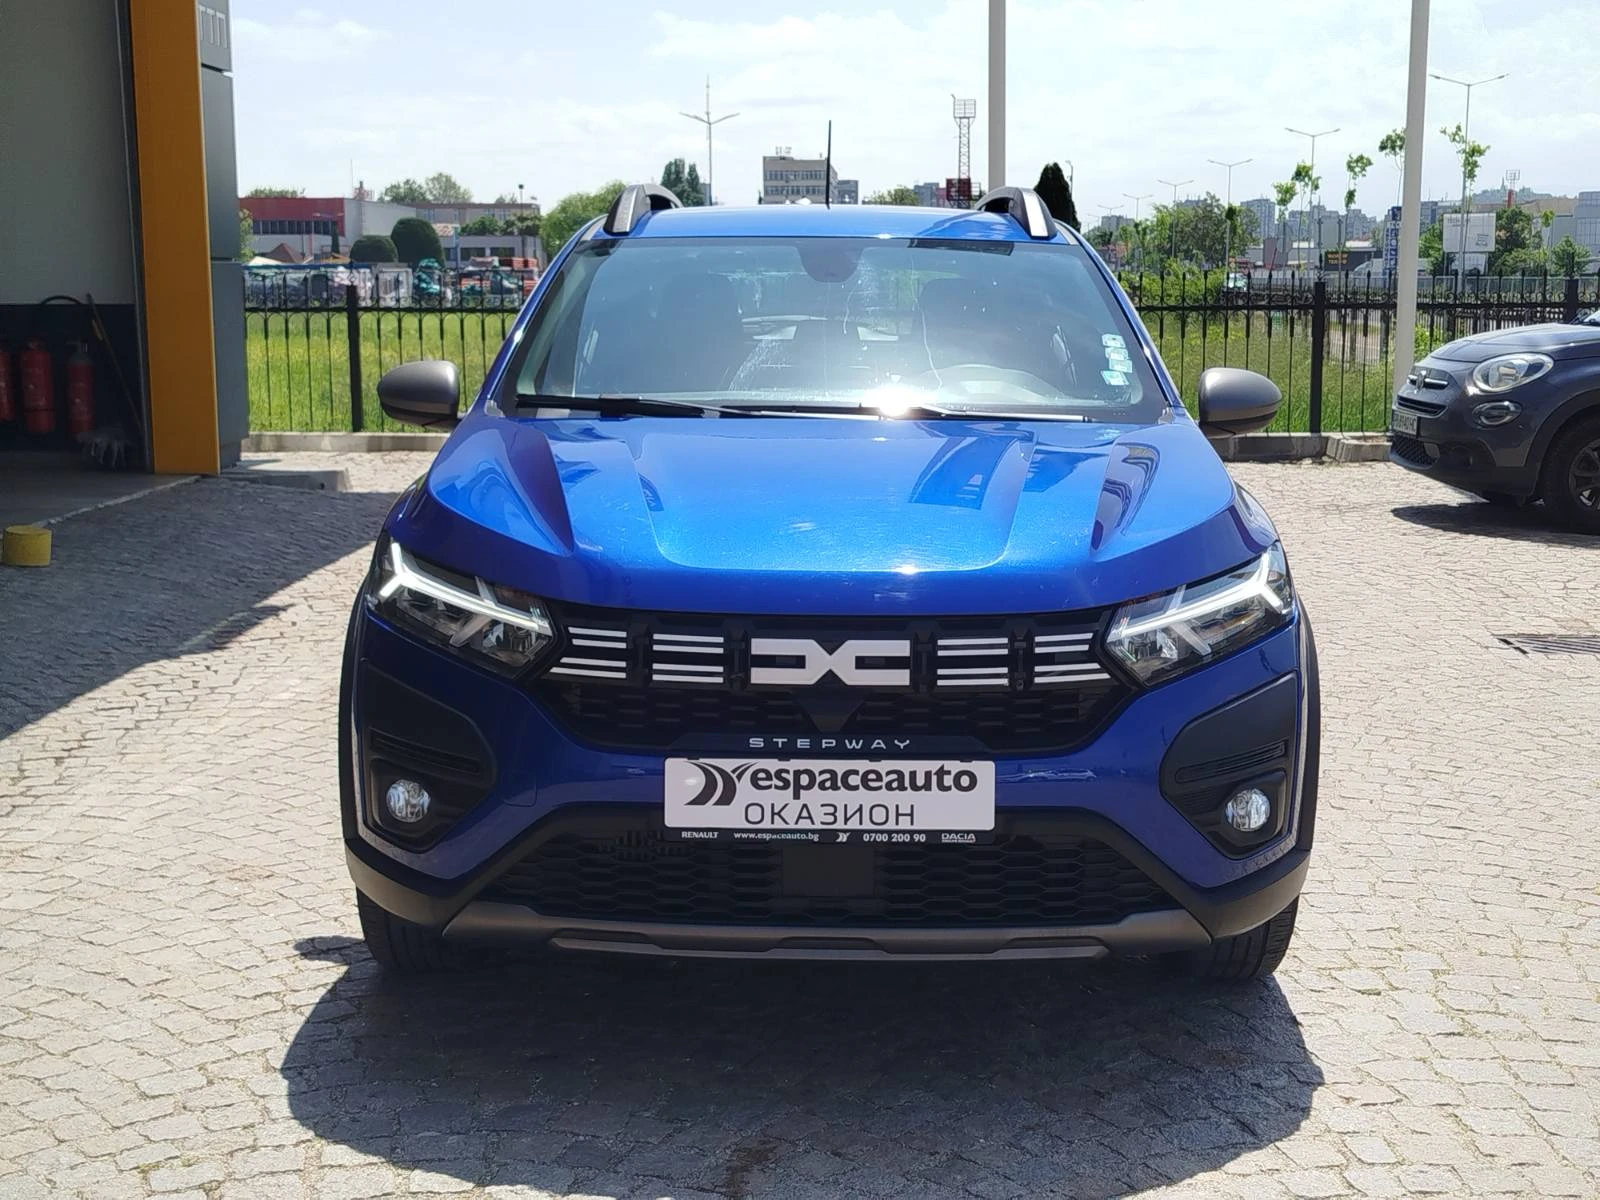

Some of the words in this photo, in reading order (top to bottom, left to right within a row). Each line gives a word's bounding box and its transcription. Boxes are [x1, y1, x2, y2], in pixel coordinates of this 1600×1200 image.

[749, 738, 910, 750] STEPWAY
[750, 763, 978, 801] espaceauto
[744, 803, 915, 826] ОКАЗИОН
[681, 831, 719, 839] RENAULT
[733, 831, 820, 842] www.espaceauto.bg
[863, 833, 889, 843] 0700
[891, 833, 911, 843] 200
[913, 833, 926, 843] 90
